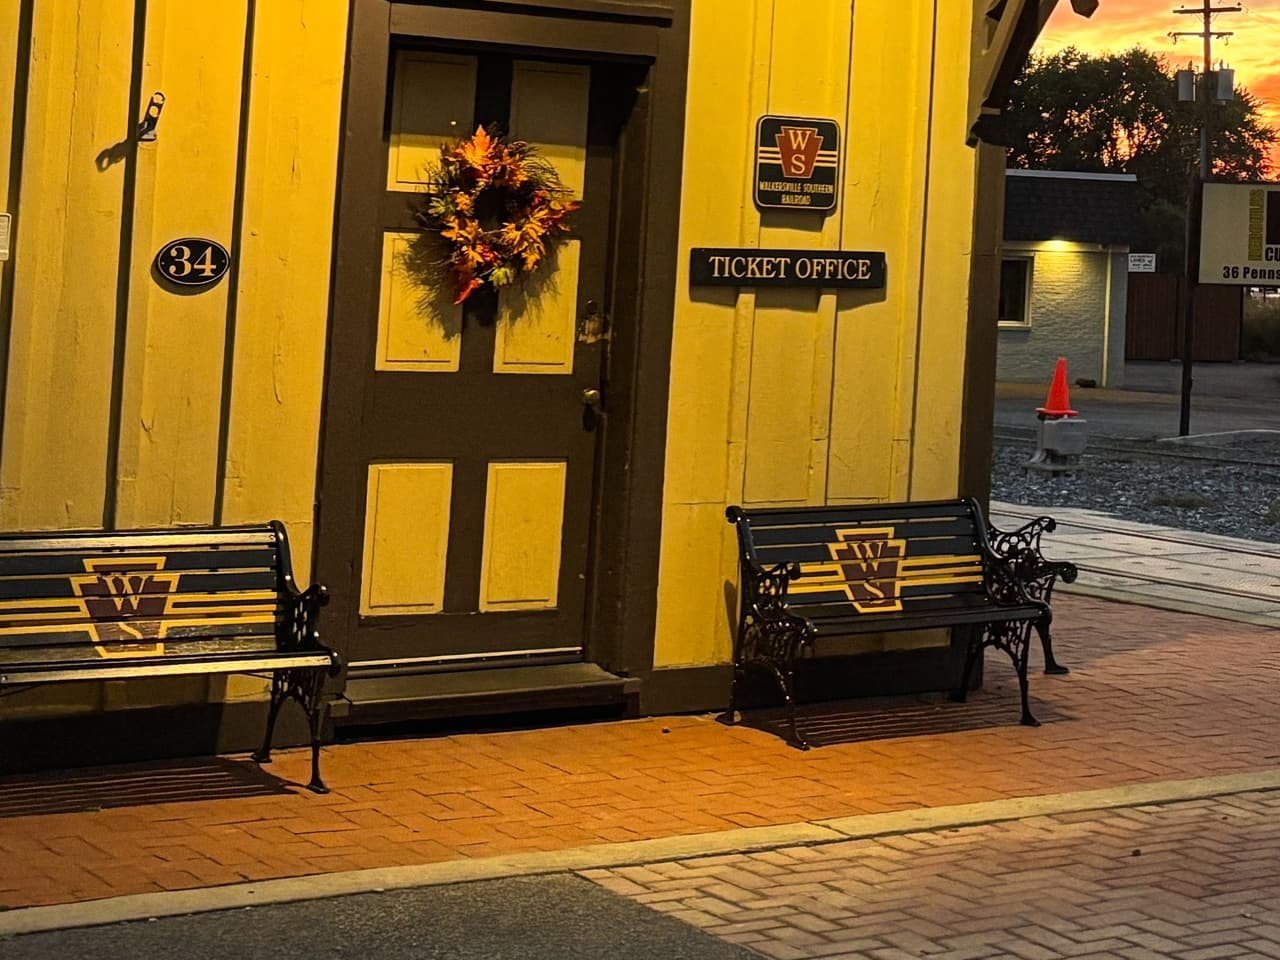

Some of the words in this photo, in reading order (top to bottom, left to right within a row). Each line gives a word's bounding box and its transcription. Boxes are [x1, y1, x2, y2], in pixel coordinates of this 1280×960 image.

[788, 129, 813, 151] W
[791, 153, 806, 175] S
[168, 244, 217, 277] 34
[709, 256, 791, 279] TICKET
[795, 257, 872, 280] OFFICE
[1222, 266, 1239, 279] 36
[850, 542, 884, 573] W
[102, 574, 149, 612] W
